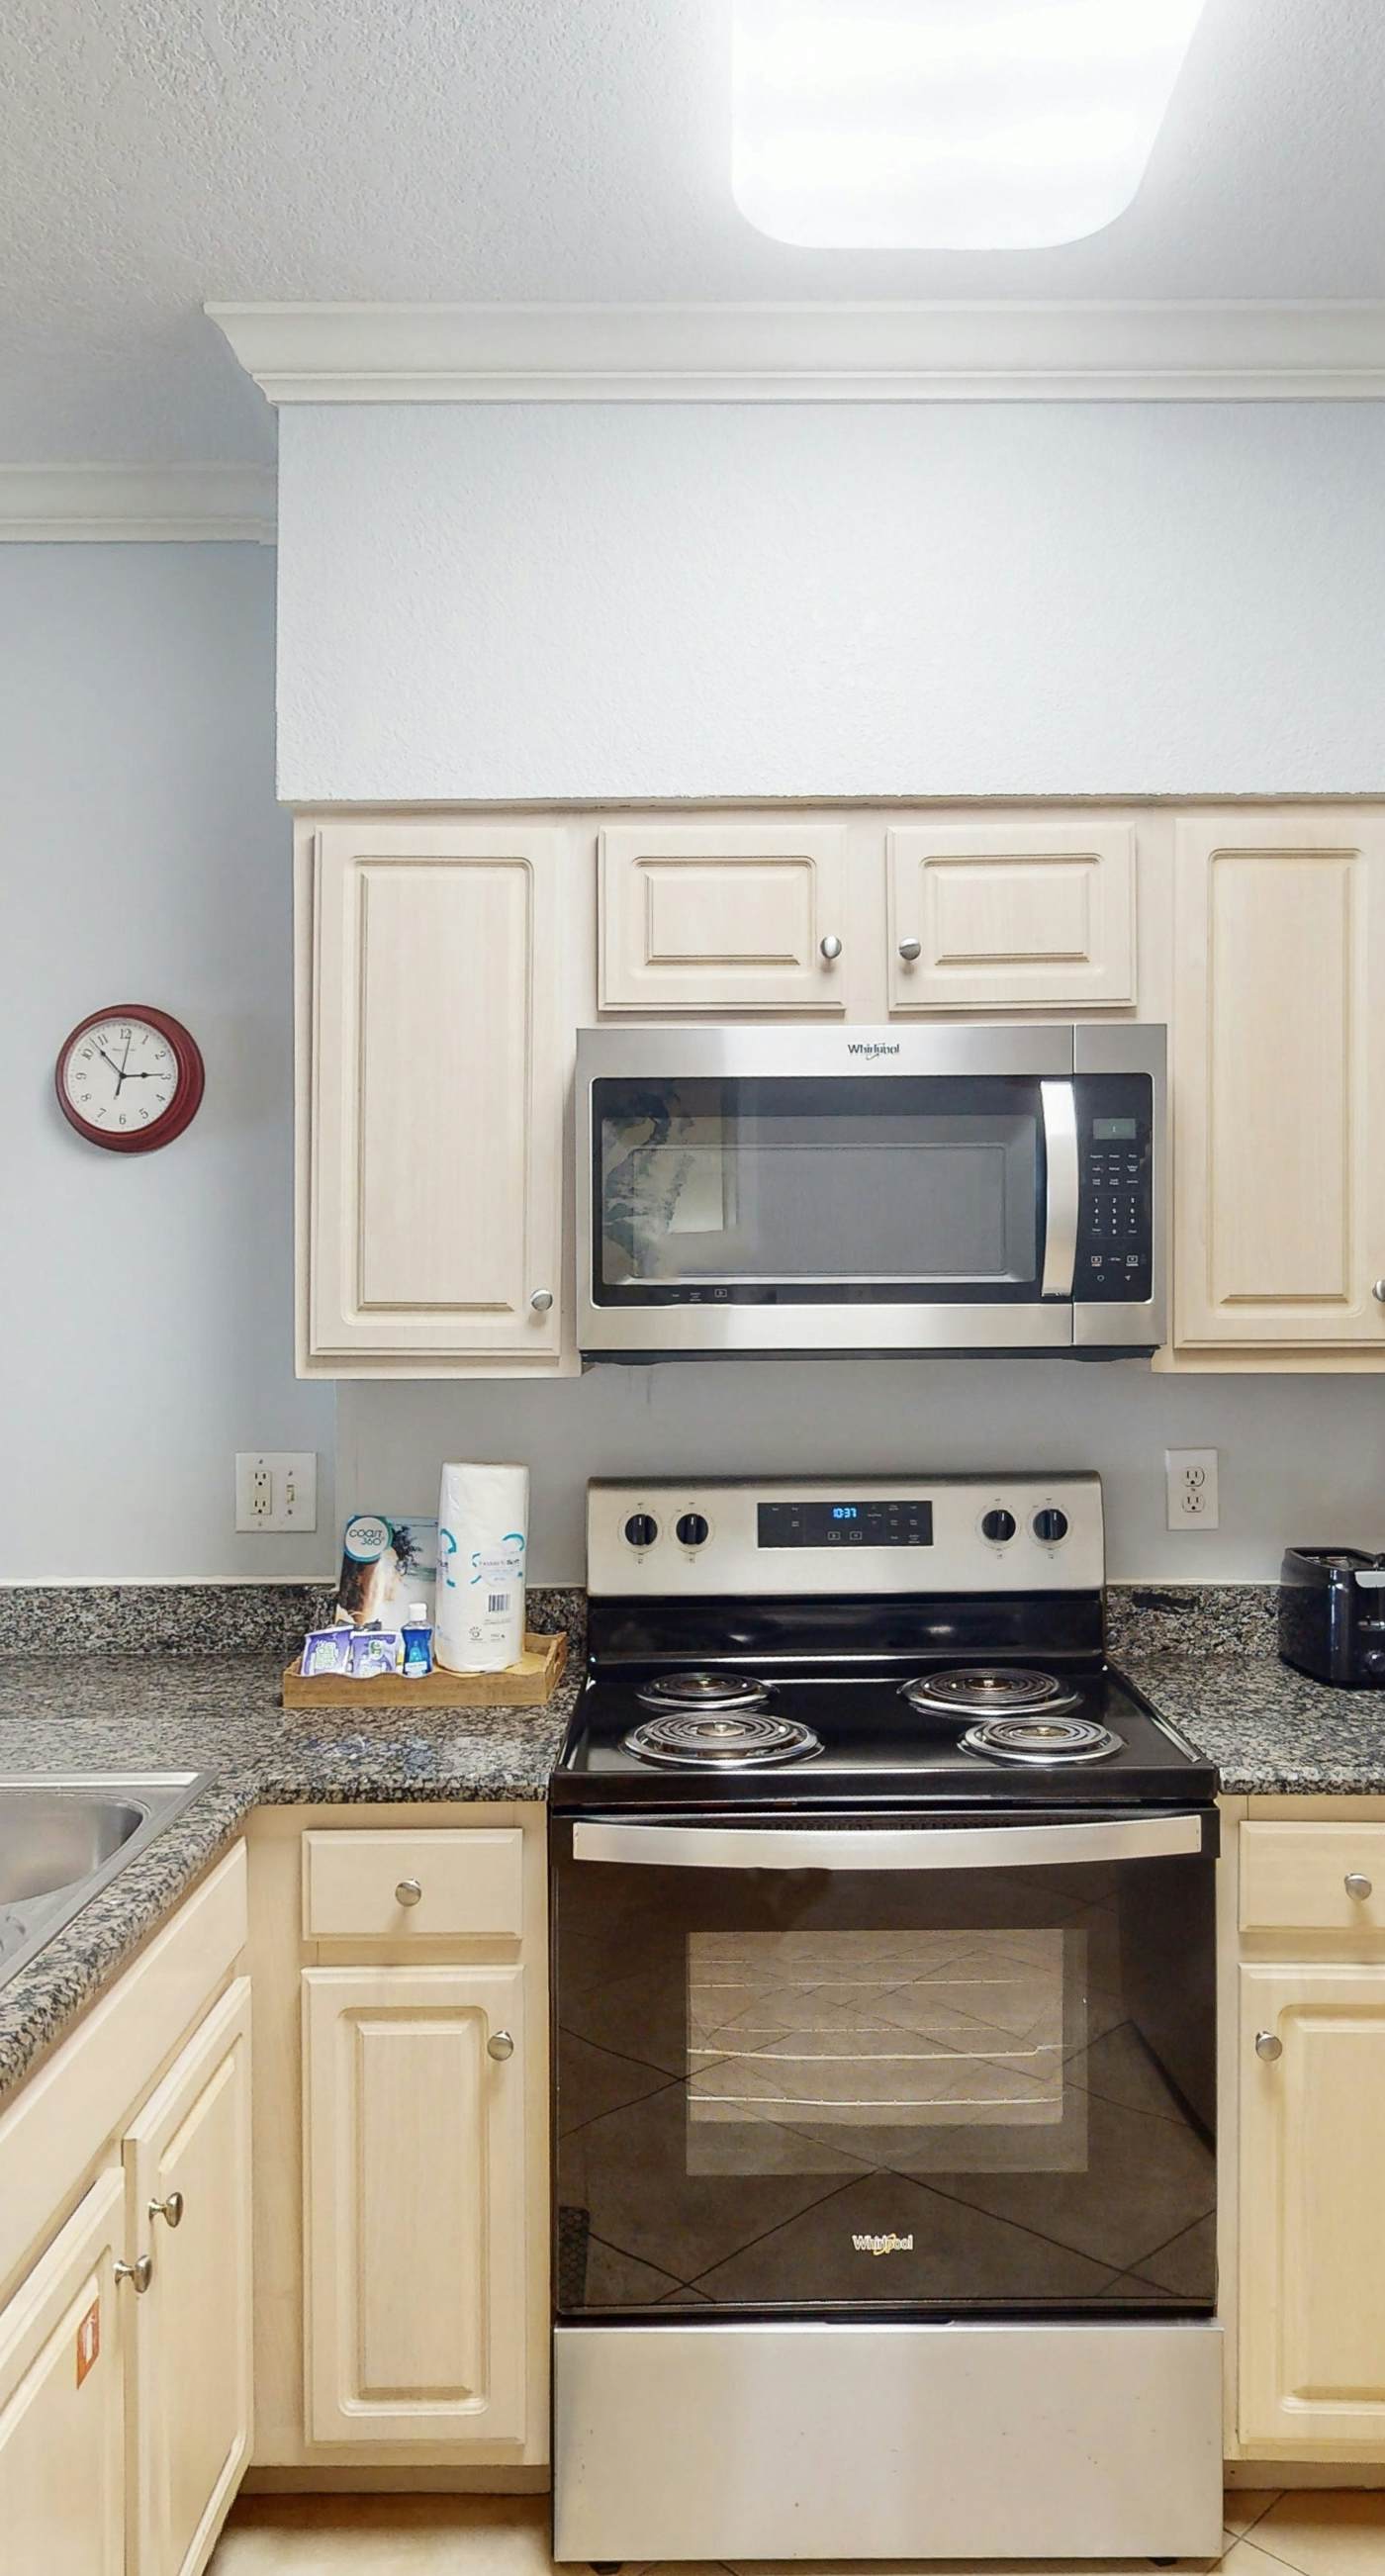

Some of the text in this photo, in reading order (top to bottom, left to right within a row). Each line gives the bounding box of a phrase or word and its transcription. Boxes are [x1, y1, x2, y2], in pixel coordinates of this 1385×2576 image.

[119, 1028, 132, 1040] 12
[97, 1034, 109, 1046] 11
[141, 1035, 149, 1046] 1
[81, 1049, 94, 1060] 10
[154, 1051, 166, 1060] 2
[97, 1108, 107, 1119] 7
[138, 1108, 149, 1120] 5
[119, 1114, 127, 1125] 6
[832, 1507, 858, 1518] 10:37
[852, 2233, 913, 2254] Whirlpool
